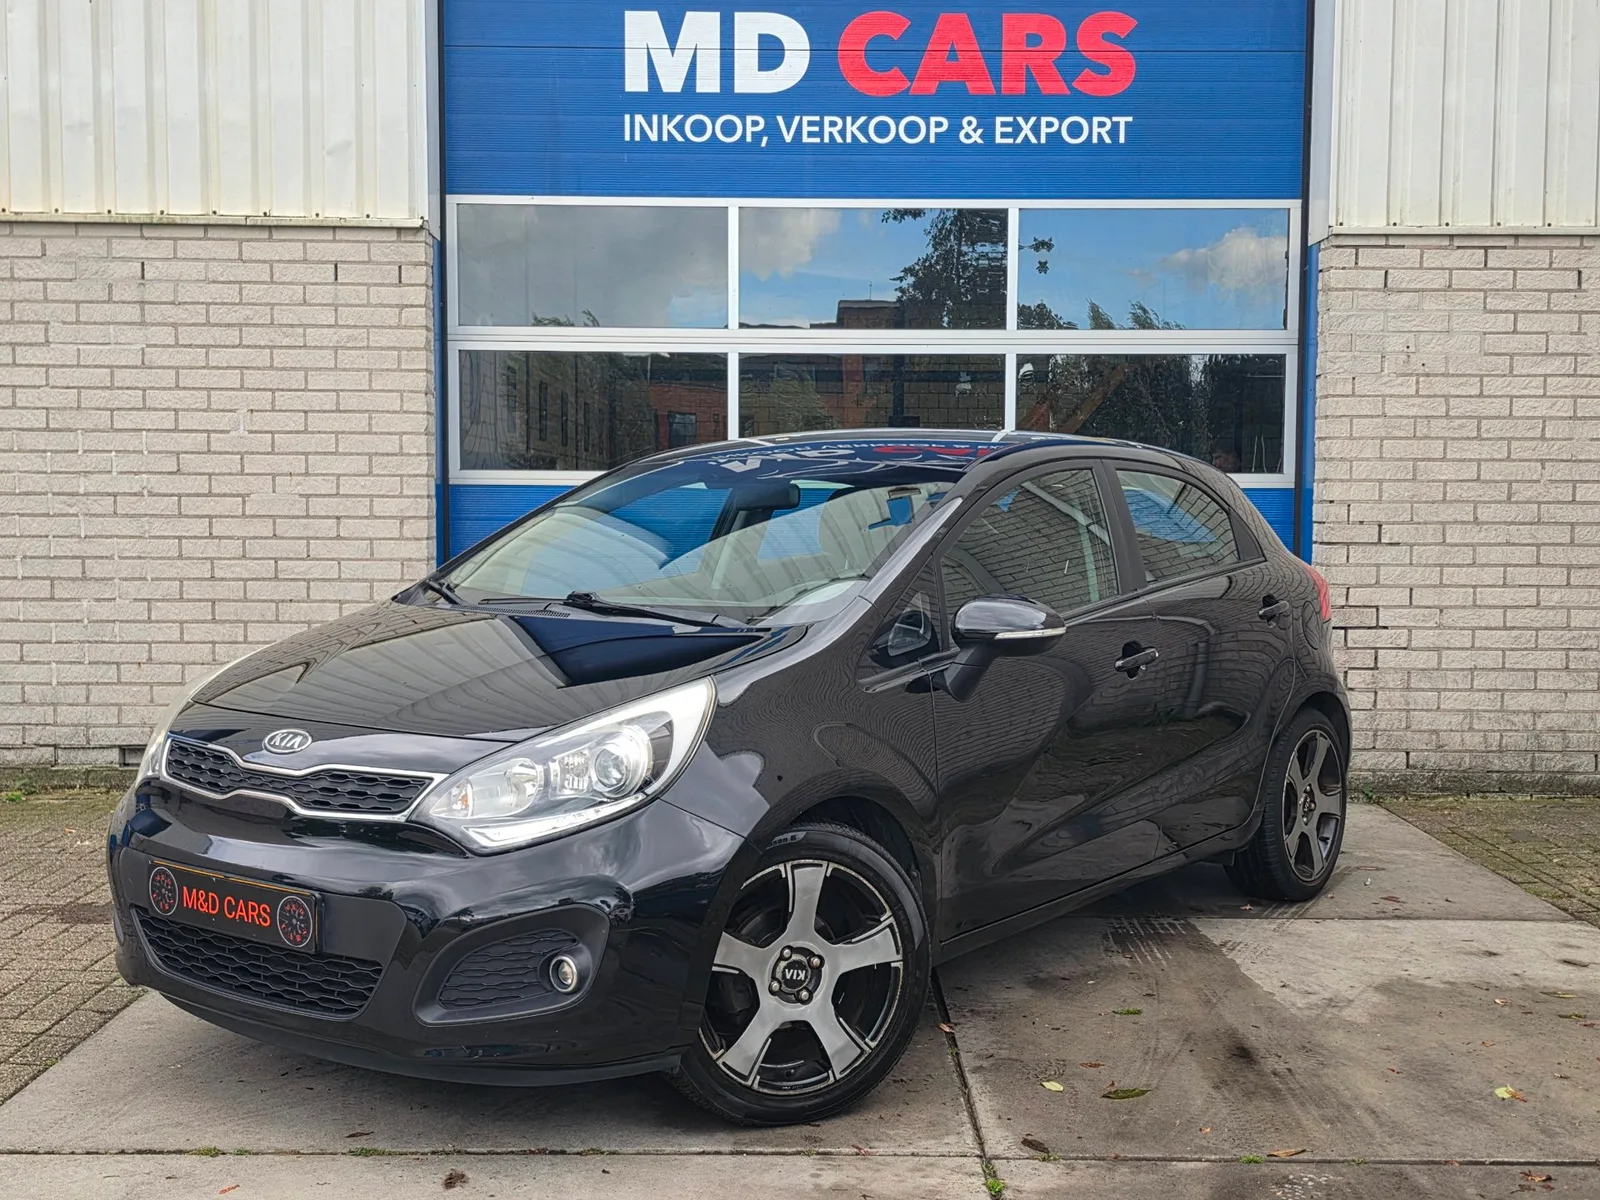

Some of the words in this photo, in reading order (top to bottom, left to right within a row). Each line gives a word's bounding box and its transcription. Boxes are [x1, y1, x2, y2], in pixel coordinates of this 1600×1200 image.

[624, 11, 810, 94] MD
[838, 11, 1138, 96] CARS
[624, 114, 767, 147] INKOOP,
[777, 115, 949, 144] VERKOOP
[959, 116, 984, 144] &
[995, 115, 1133, 144] EXPORT
[270, 733, 303, 749] KIA
[182, 885, 220, 914] M&D
[224, 896, 272, 927] CARS
[785, 968, 806, 981] KIA
